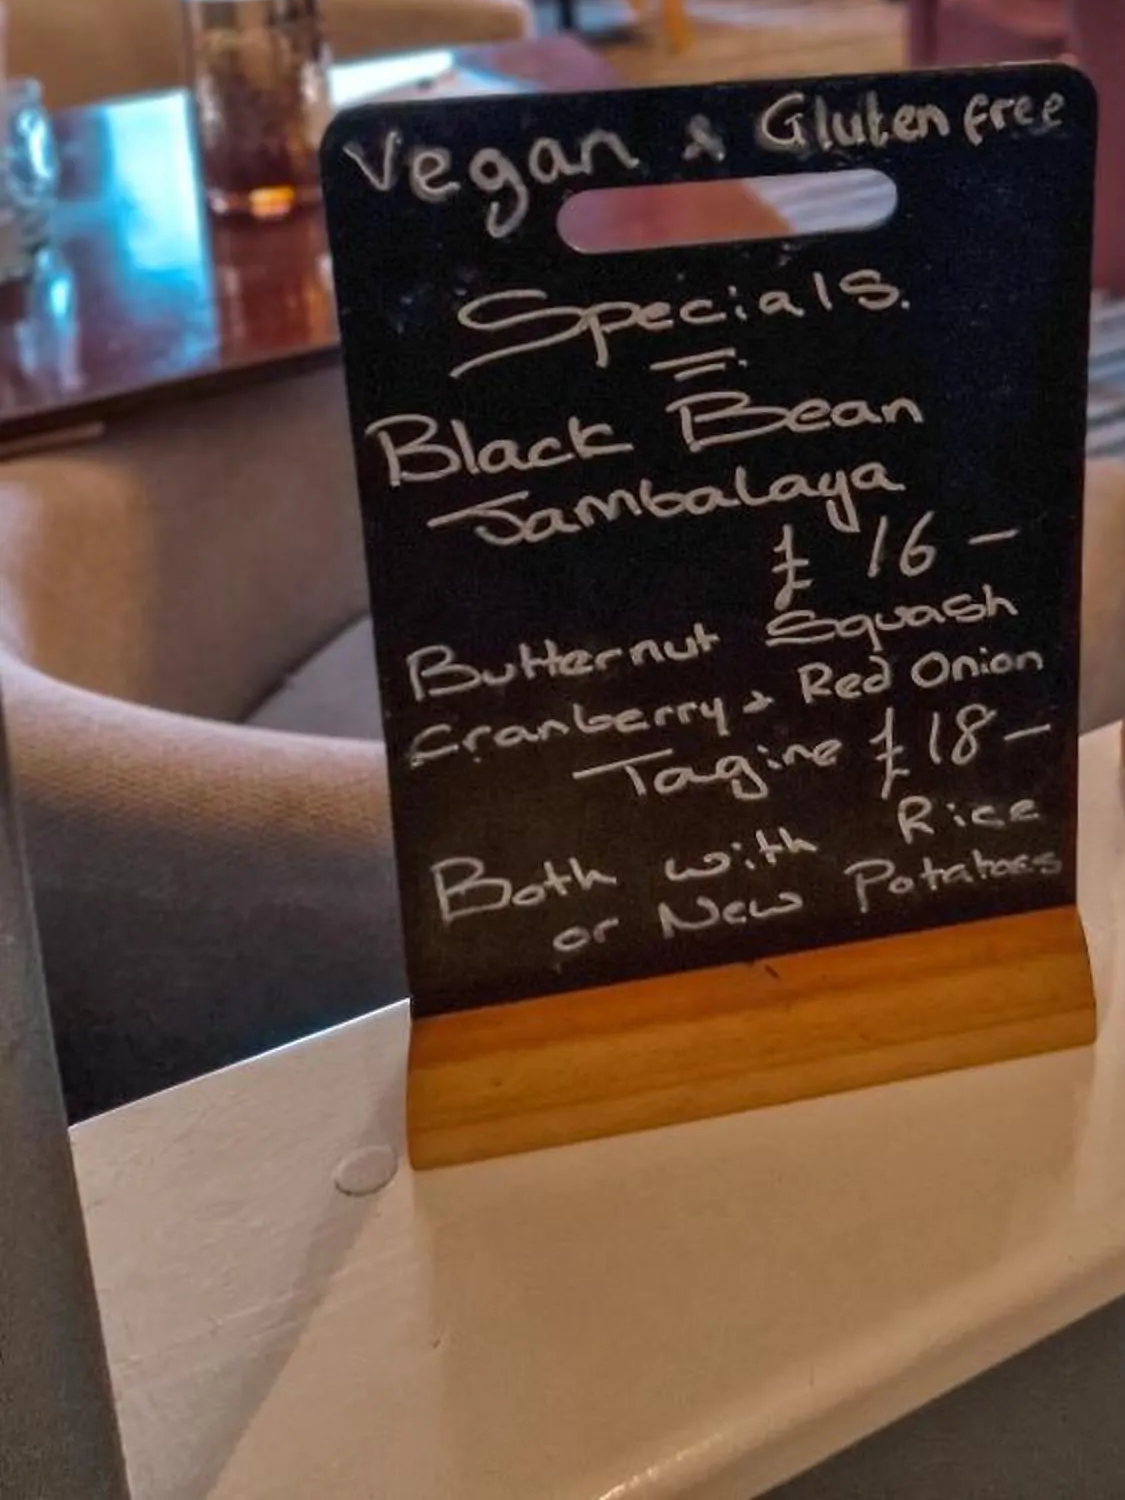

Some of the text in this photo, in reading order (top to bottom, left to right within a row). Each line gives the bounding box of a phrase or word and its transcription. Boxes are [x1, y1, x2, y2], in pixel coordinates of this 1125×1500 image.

[341, 128, 640, 237] Vegan
[757, 91, 950, 154] Gluten
[365, 391, 924, 487] Black Bean
[427, 460, 904, 547] Jambalaya
[407, 584, 1019, 700] Butternut Squash
[409, 695, 730, 769] Cranberry
[799, 656, 893, 703] Red
[911, 645, 1044, 690] Onion
[572, 739, 844, 800] Tagine
[431, 795, 1040, 925] Both with Rice
[552, 919, 620, 955] or
[660, 890, 805, 940] New
